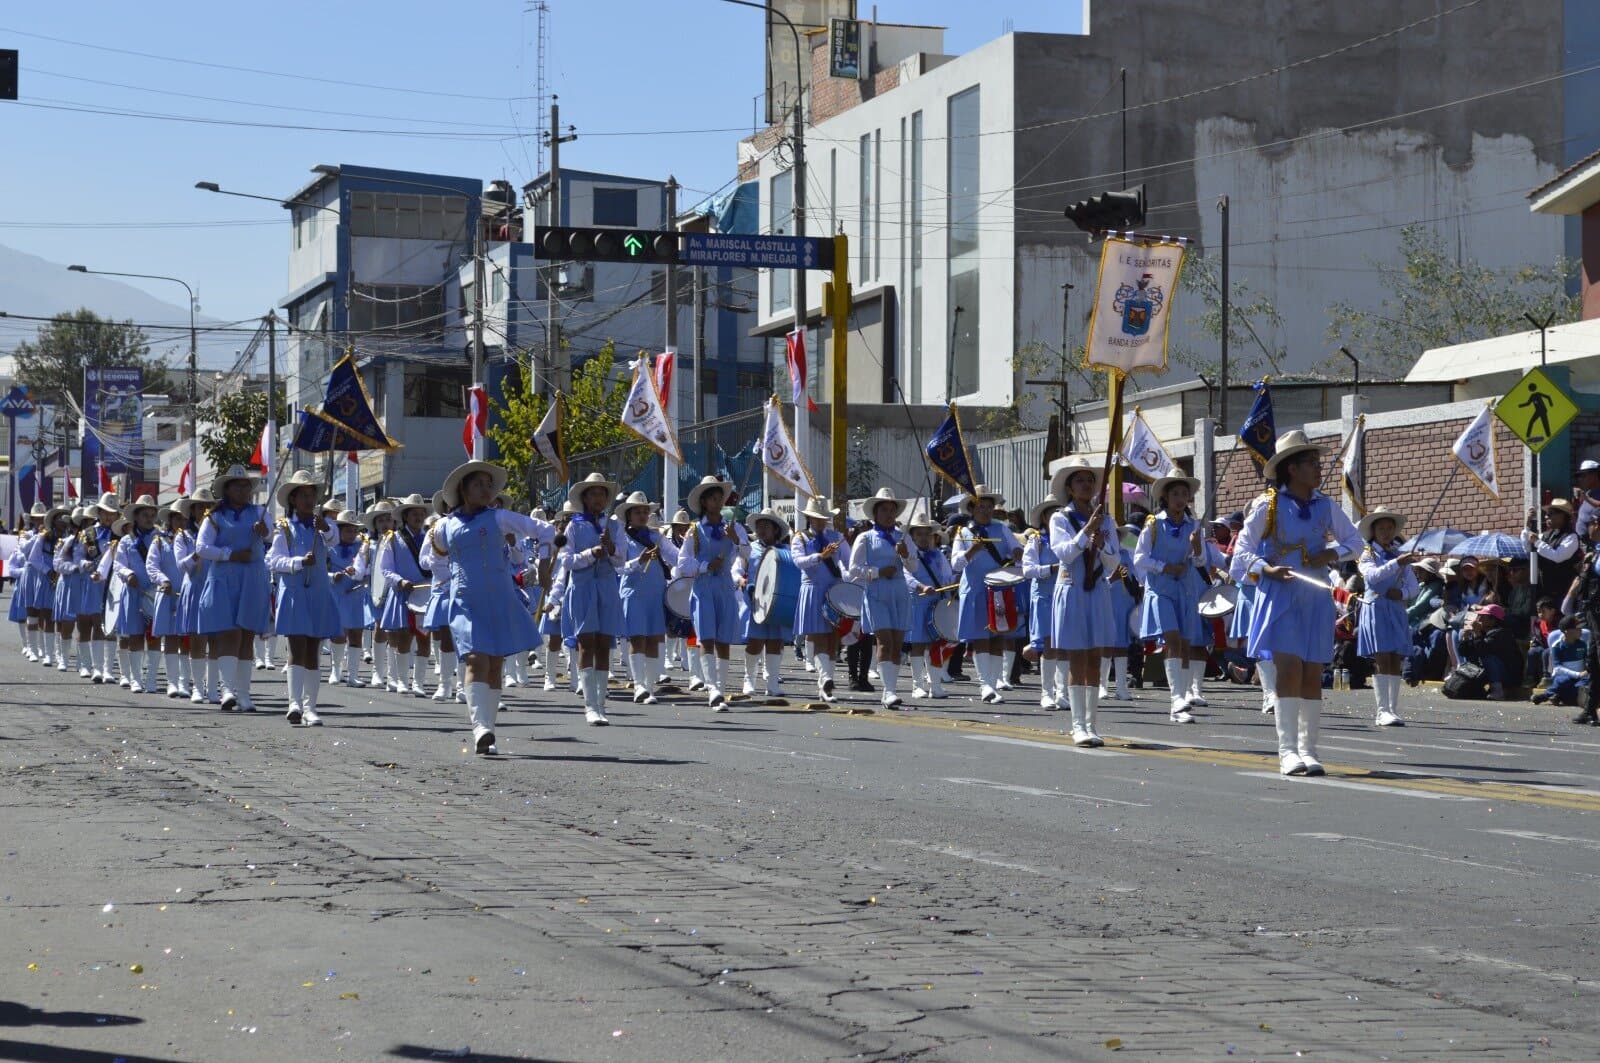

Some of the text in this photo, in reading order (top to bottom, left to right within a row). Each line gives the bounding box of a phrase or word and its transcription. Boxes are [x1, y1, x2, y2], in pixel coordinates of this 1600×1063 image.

[835, 21, 844, 70] HOSTAL
[690, 238, 796, 252] Av. MARISCAL CASTILLA
[690, 250, 746, 261] MIRAFLORES
[1107, 336, 1129, 347] BANDA
[2, 399, 34, 409] AVA
